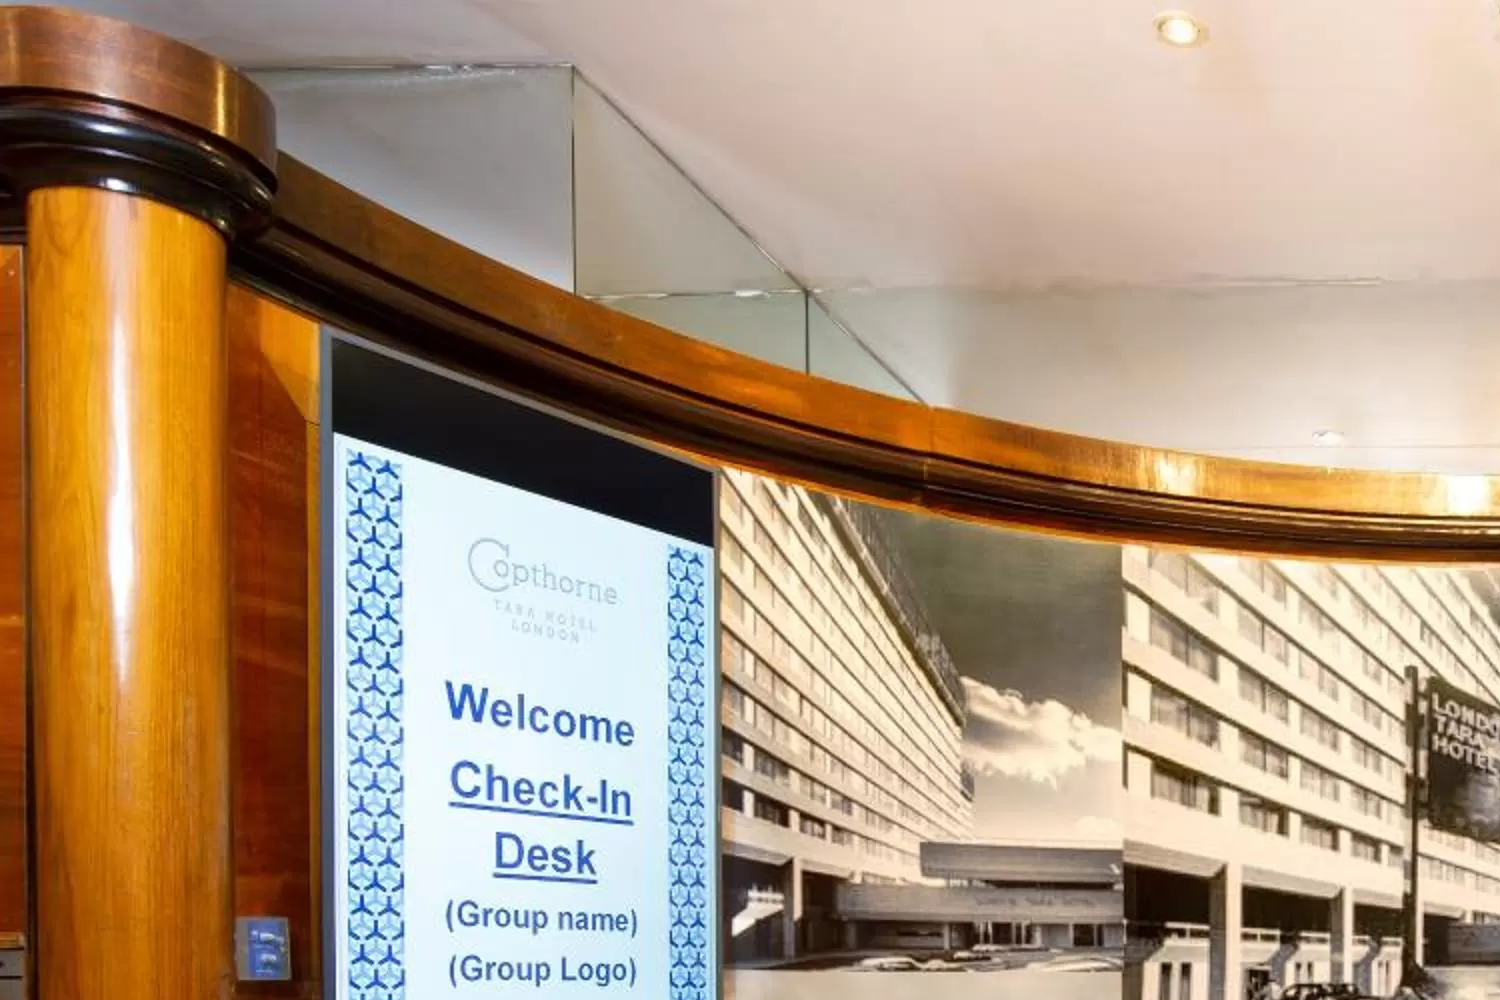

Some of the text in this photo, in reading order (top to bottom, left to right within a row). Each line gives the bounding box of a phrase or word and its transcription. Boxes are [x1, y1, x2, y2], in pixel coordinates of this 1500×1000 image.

[468, 537, 618, 605] Copthorne
[495, 599, 535, 620] TARA
[511, 618, 579, 644] LONDON
[445, 680, 634, 746] Welcome
[1434, 712, 1485, 749] TARA
[1432, 734, 1498, 776] HOTEL
[450, 760, 631, 816] Check-In
[495, 831, 597, 875] Desk
[446, 899, 637, 938] (Group name)
[450, 954, 636, 988] (Group Logo)
